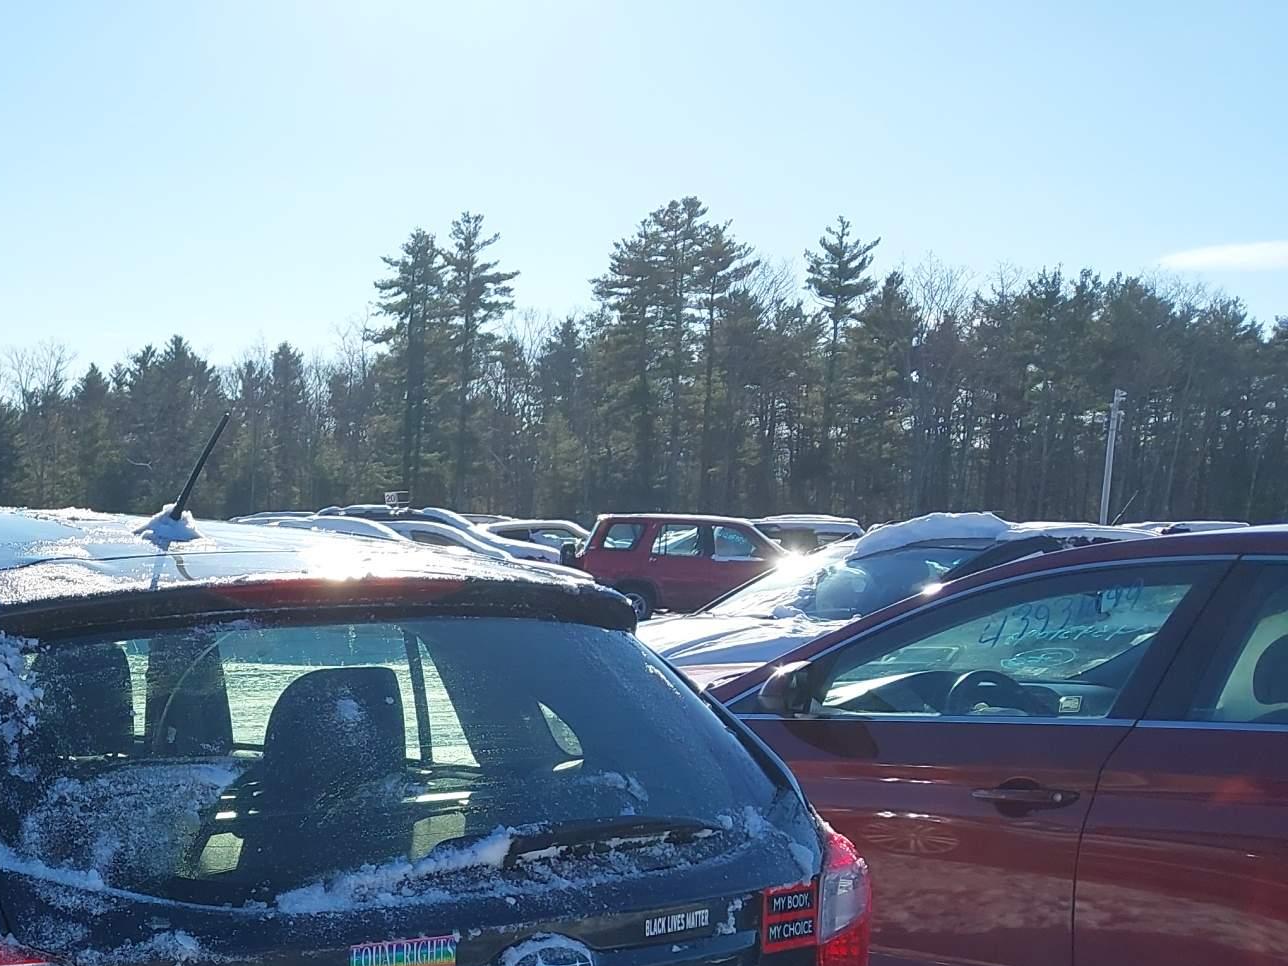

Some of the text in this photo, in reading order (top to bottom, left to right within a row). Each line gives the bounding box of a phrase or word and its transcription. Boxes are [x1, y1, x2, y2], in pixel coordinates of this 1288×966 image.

[386, 494, 396, 503] 20
[774, 897, 786, 911] MY
[645, 909, 709, 937] BLACK LIVES MATTER
[769, 921, 812, 940] MY CHOICE
[402, 938, 456, 966] RIGHTS
